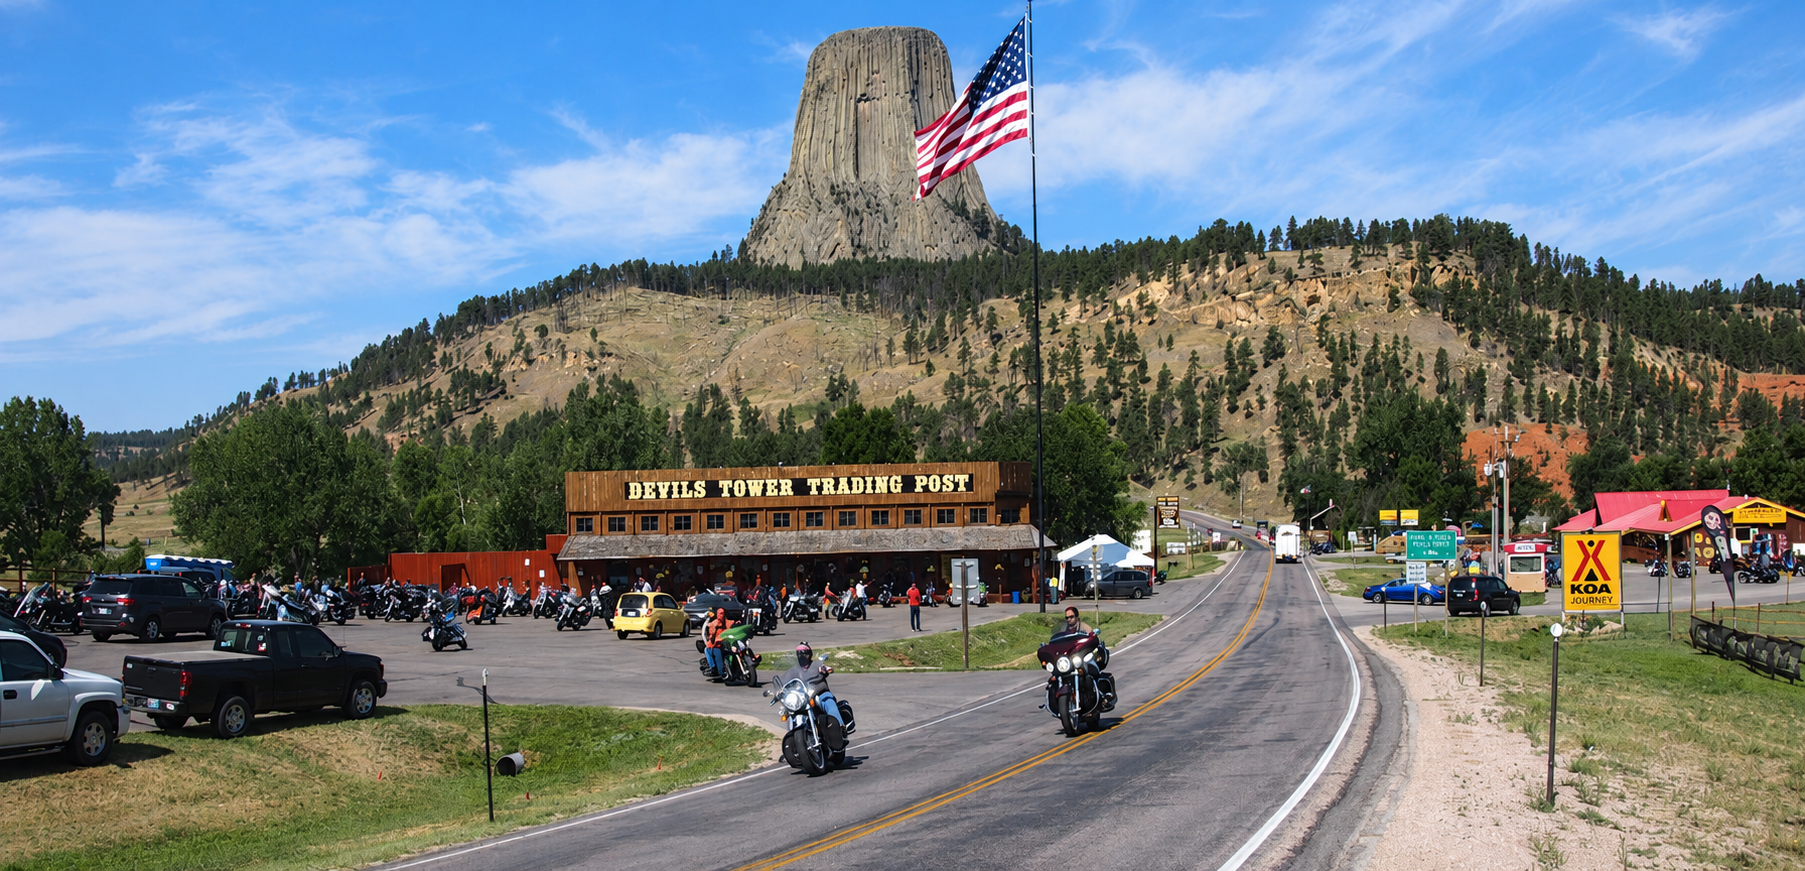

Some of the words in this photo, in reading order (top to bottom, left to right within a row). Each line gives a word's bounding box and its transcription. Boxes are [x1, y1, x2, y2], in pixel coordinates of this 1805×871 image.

[628, 480, 707, 500] DEVILS
[718, 478, 794, 498] TOWER
[806, 475, 903, 495] TRADING
[914, 474, 970, 493] POST
[1570, 583, 1612, 594] KOA
[1570, 595, 1613, 605] JOURNEY
